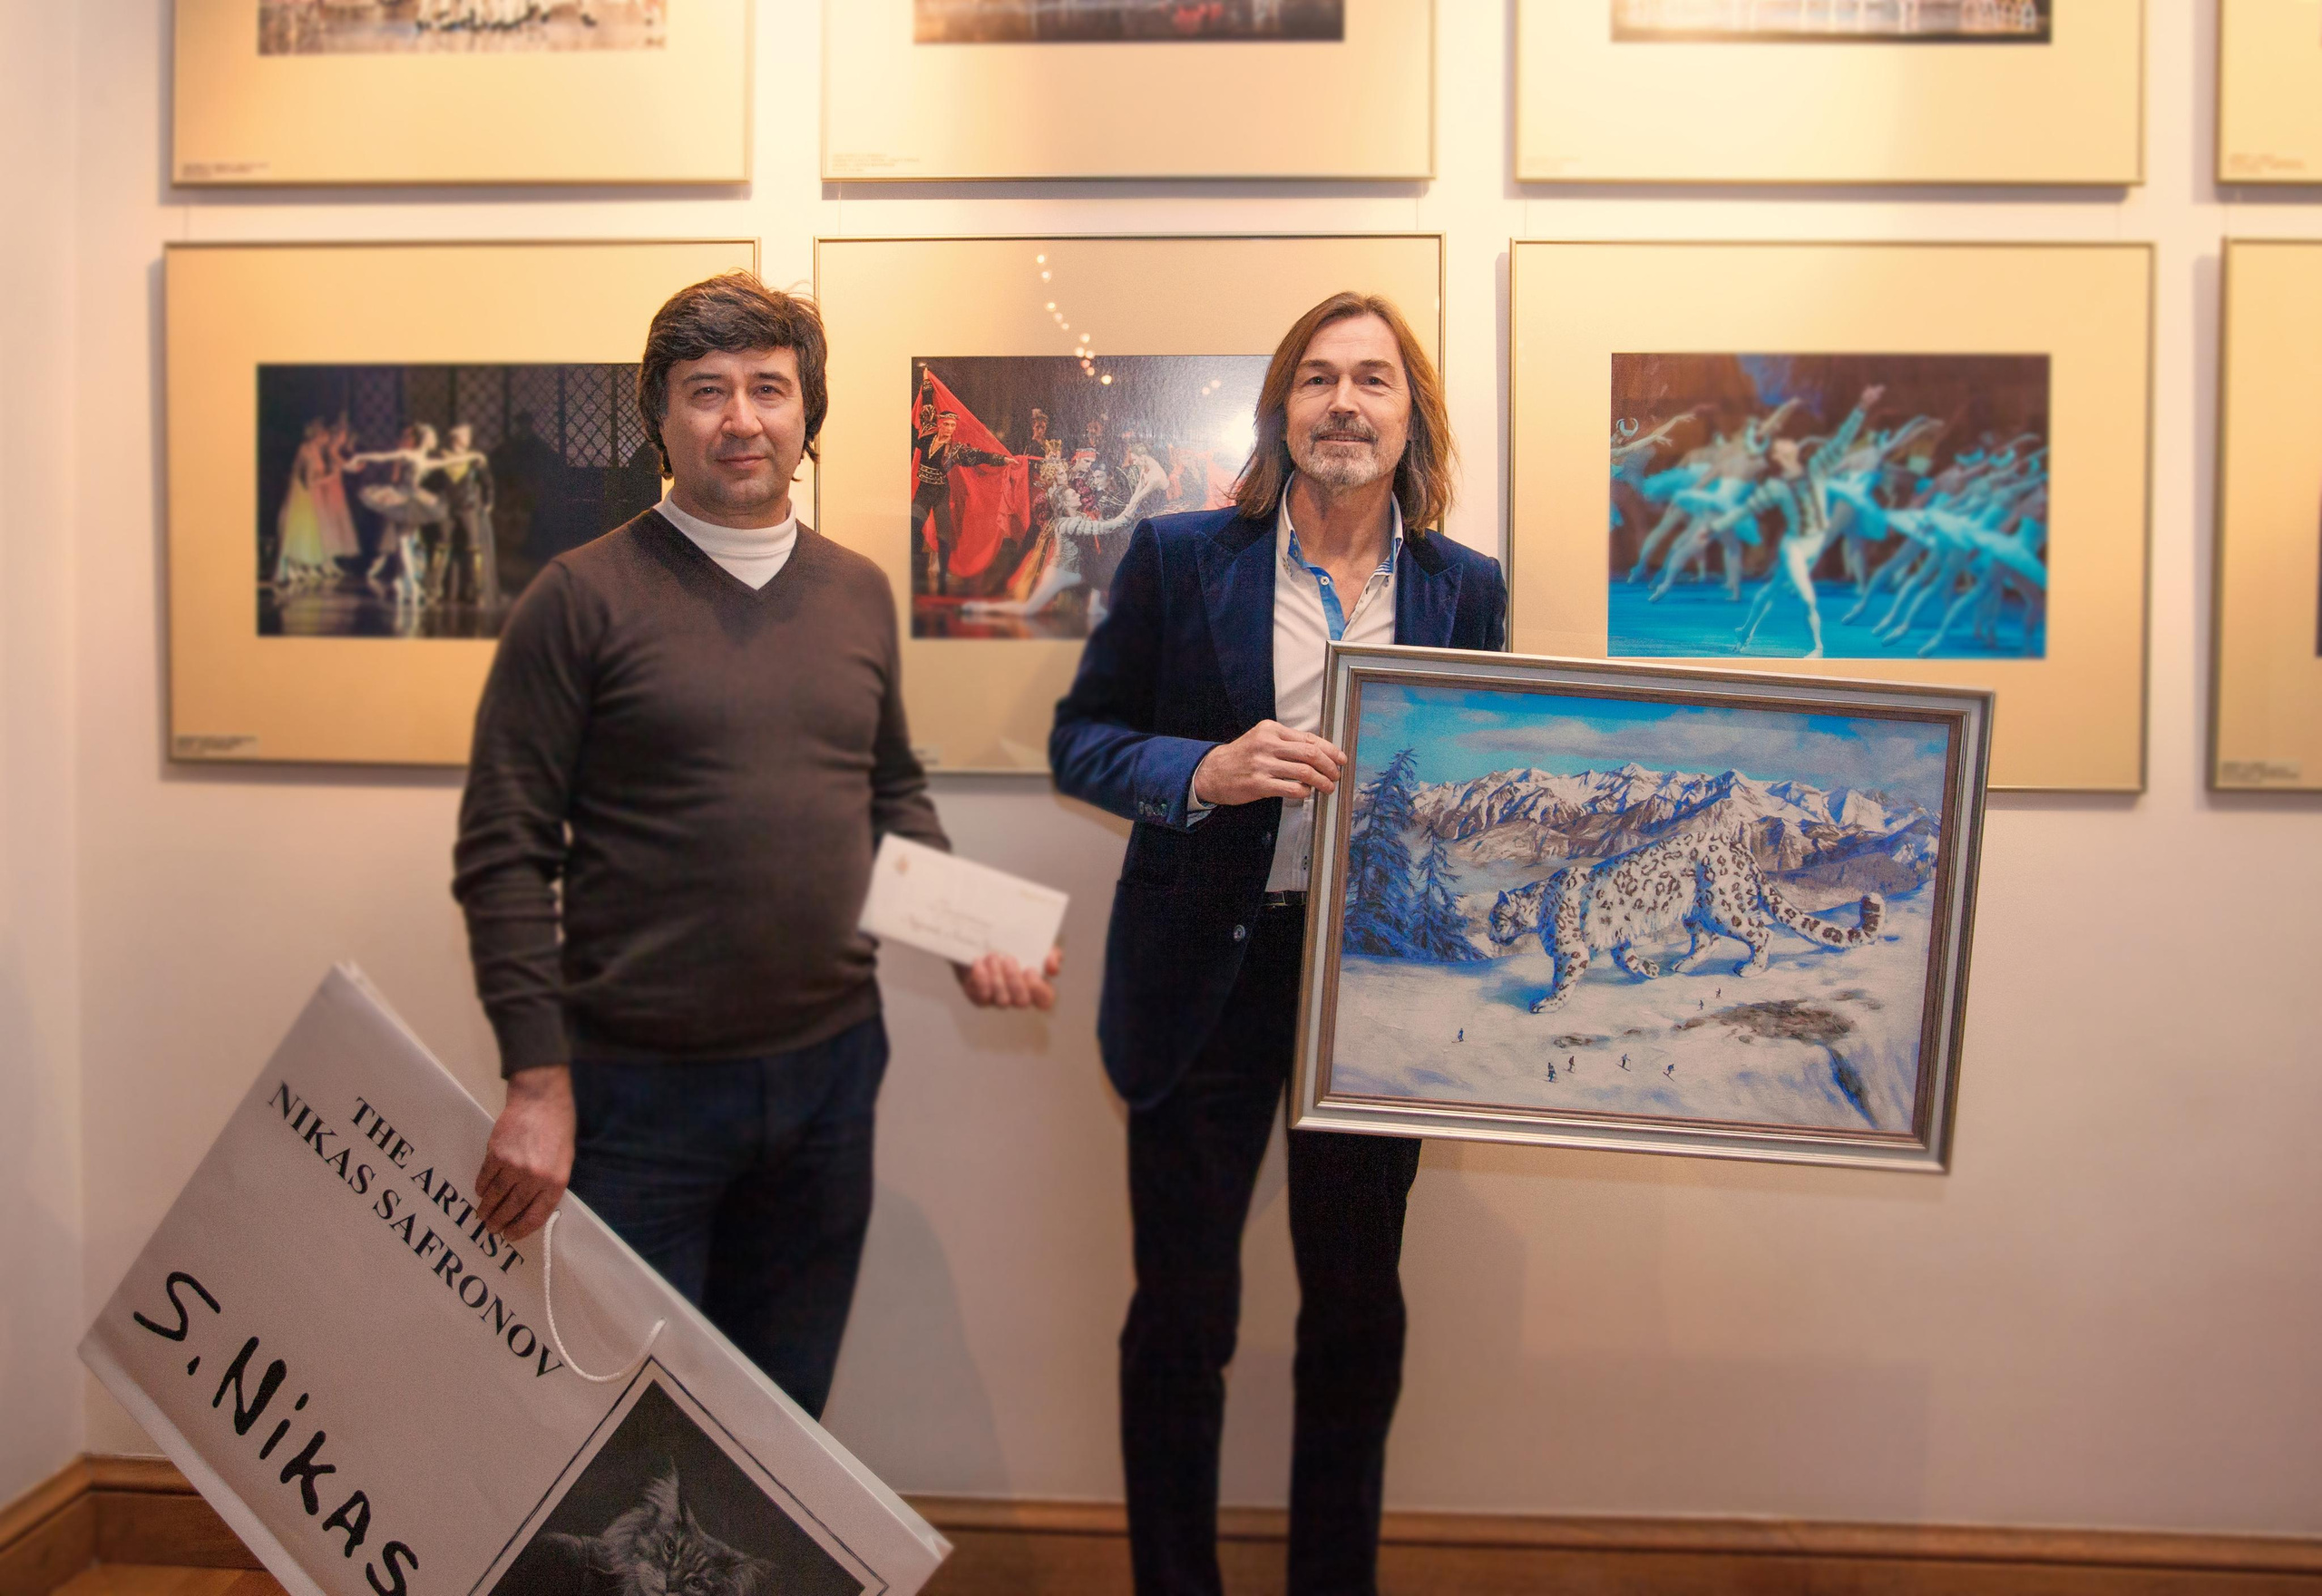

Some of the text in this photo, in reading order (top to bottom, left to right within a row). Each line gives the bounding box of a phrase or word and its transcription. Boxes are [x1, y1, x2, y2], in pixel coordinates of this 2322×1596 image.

[268, 1079, 565, 1377] NIKAS SAFRONOV
[350, 1095, 525, 1275] THE ARTIST
[132, 1270, 221, 1377] S.
